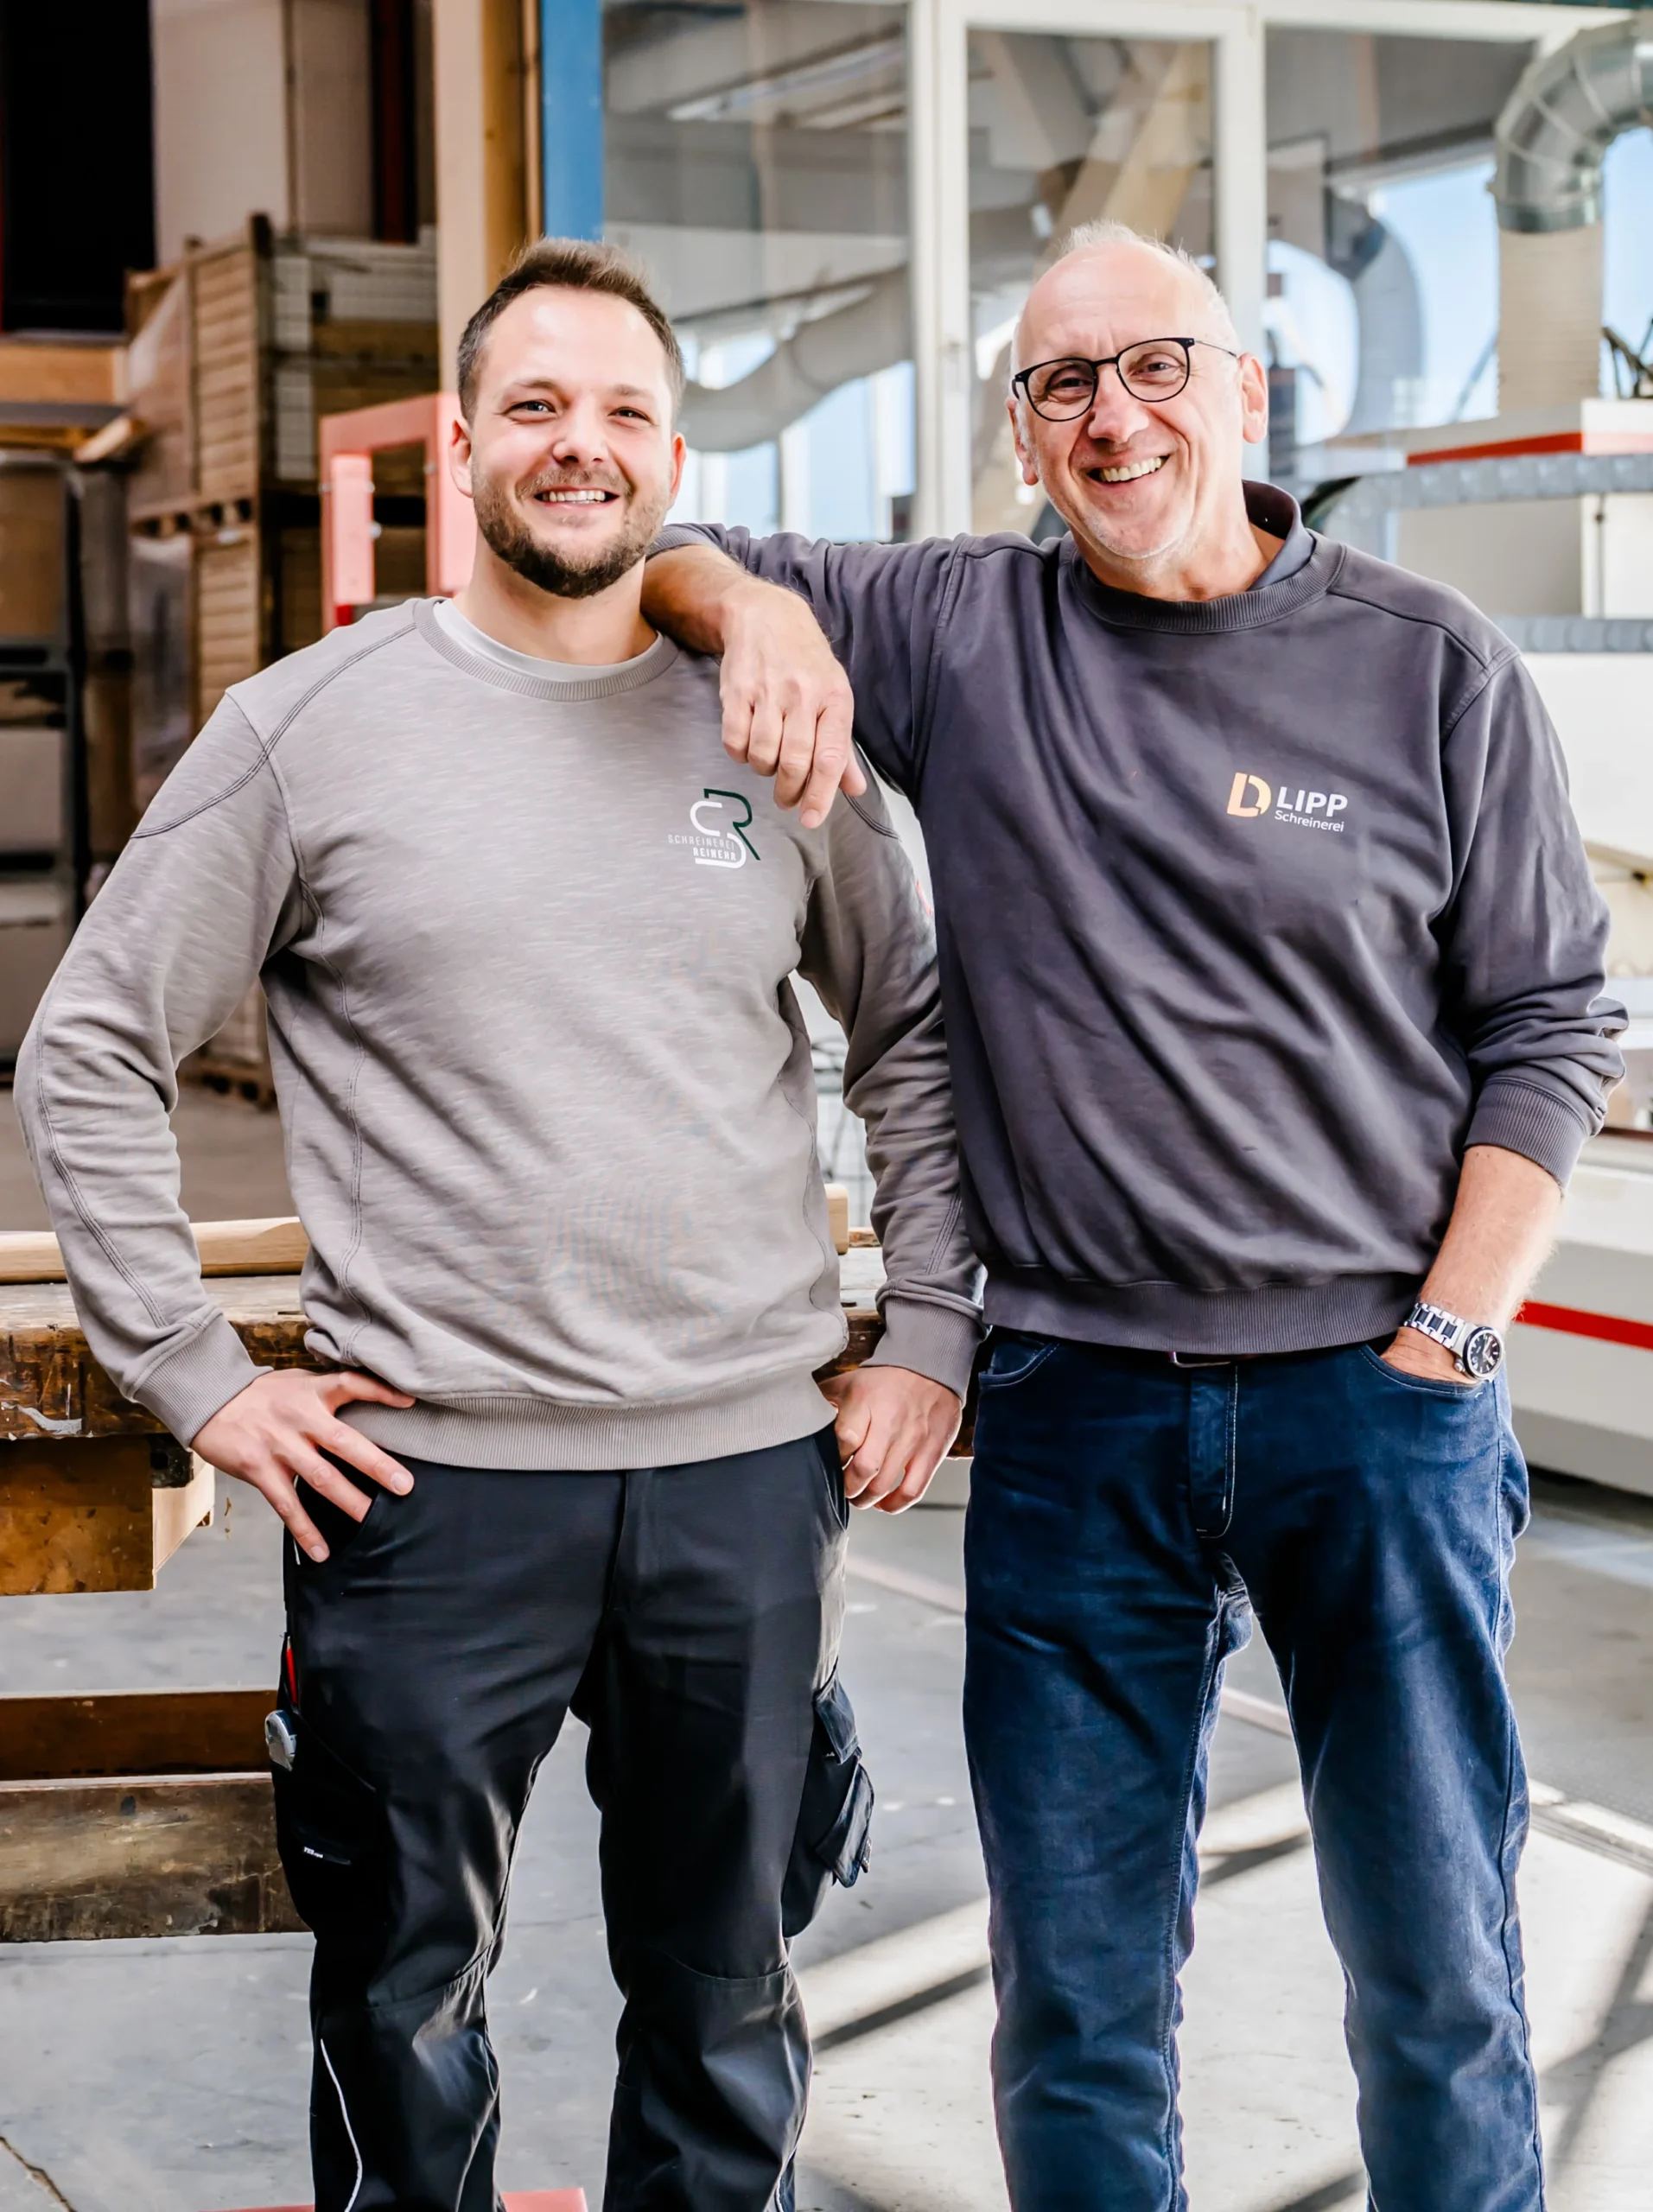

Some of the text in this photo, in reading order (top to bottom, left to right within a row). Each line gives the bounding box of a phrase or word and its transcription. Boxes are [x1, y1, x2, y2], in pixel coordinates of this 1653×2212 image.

[1276, 786, 1348, 817] LIPP
[1275, 810, 1345, 832] Schreinerei
[668, 834, 734, 850] SCHREINEREI
